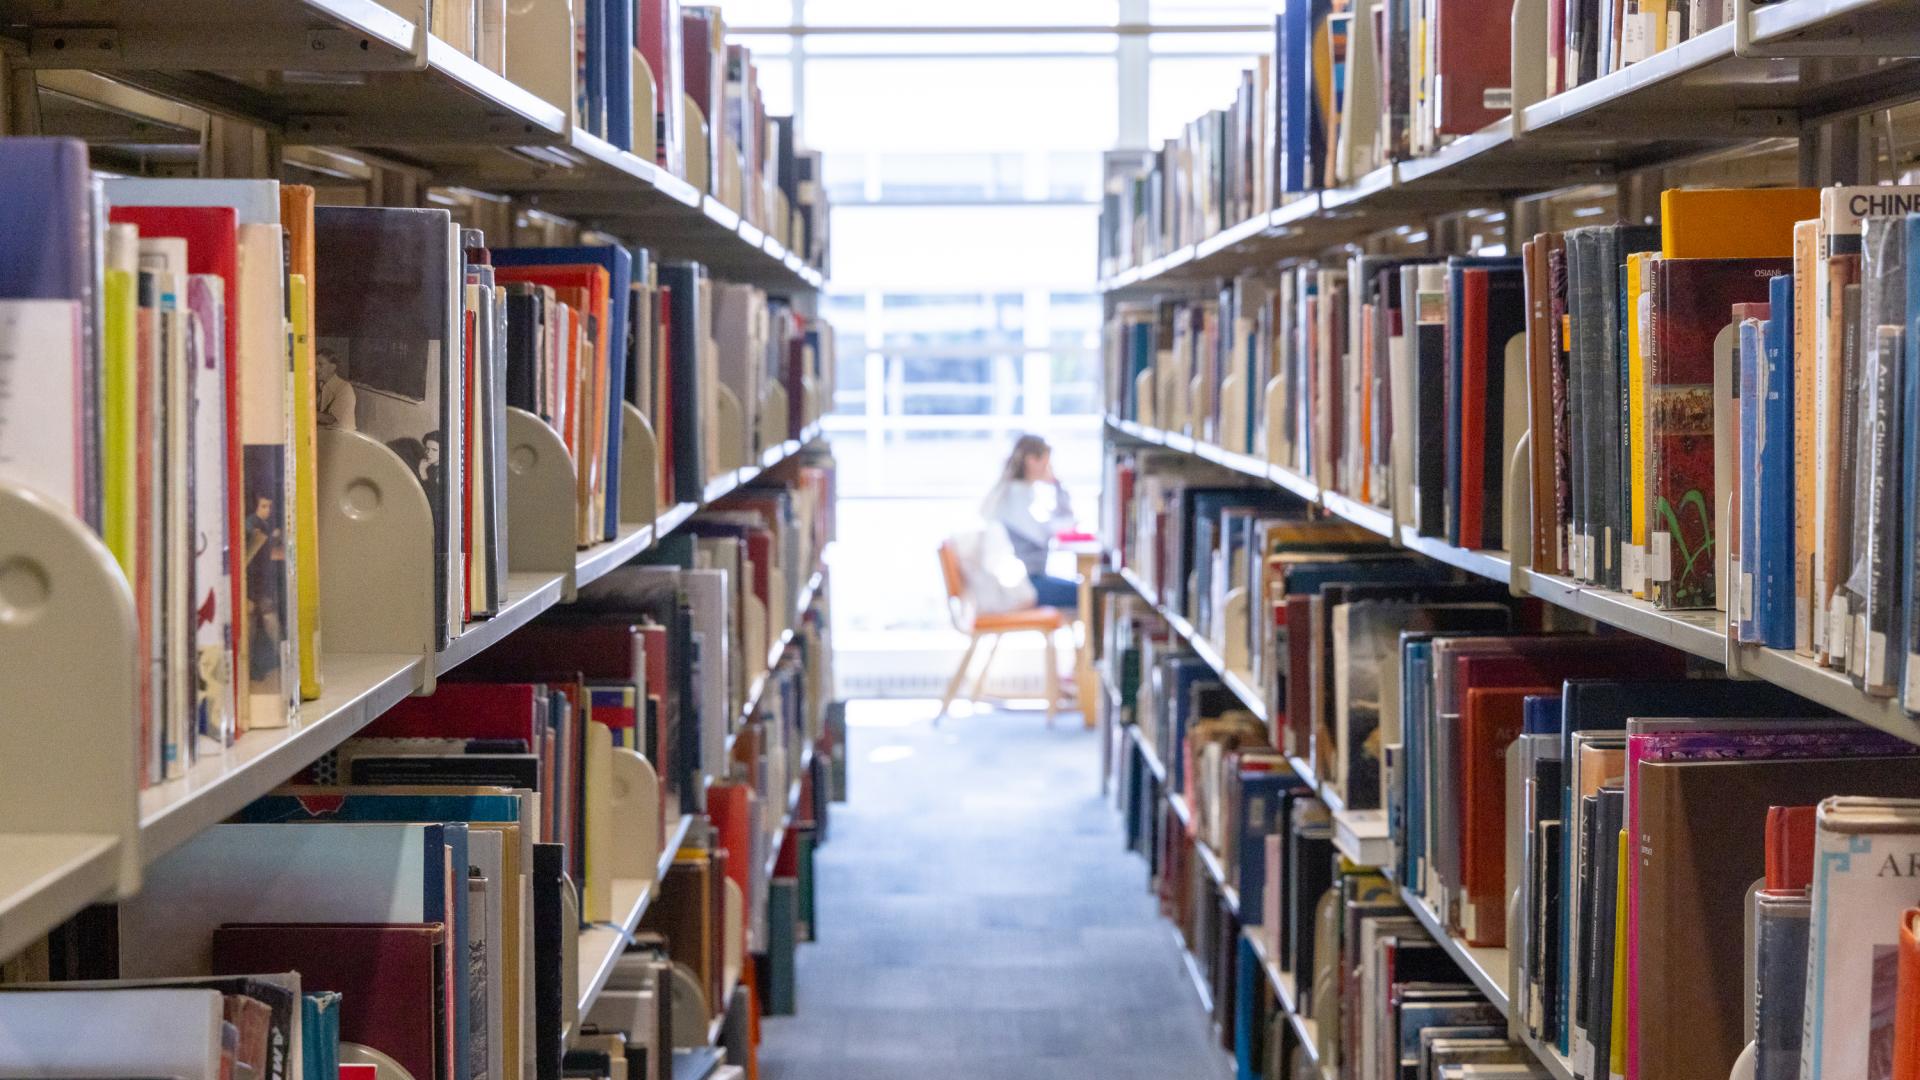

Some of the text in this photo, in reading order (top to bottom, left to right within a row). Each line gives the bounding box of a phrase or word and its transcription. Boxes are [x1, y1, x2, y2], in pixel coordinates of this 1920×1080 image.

[1878, 363, 1887, 391] Art
[1878, 398, 1886, 417] of
[1872, 535, 1881, 563] and
[1871, 570, 1880, 615] Japan
